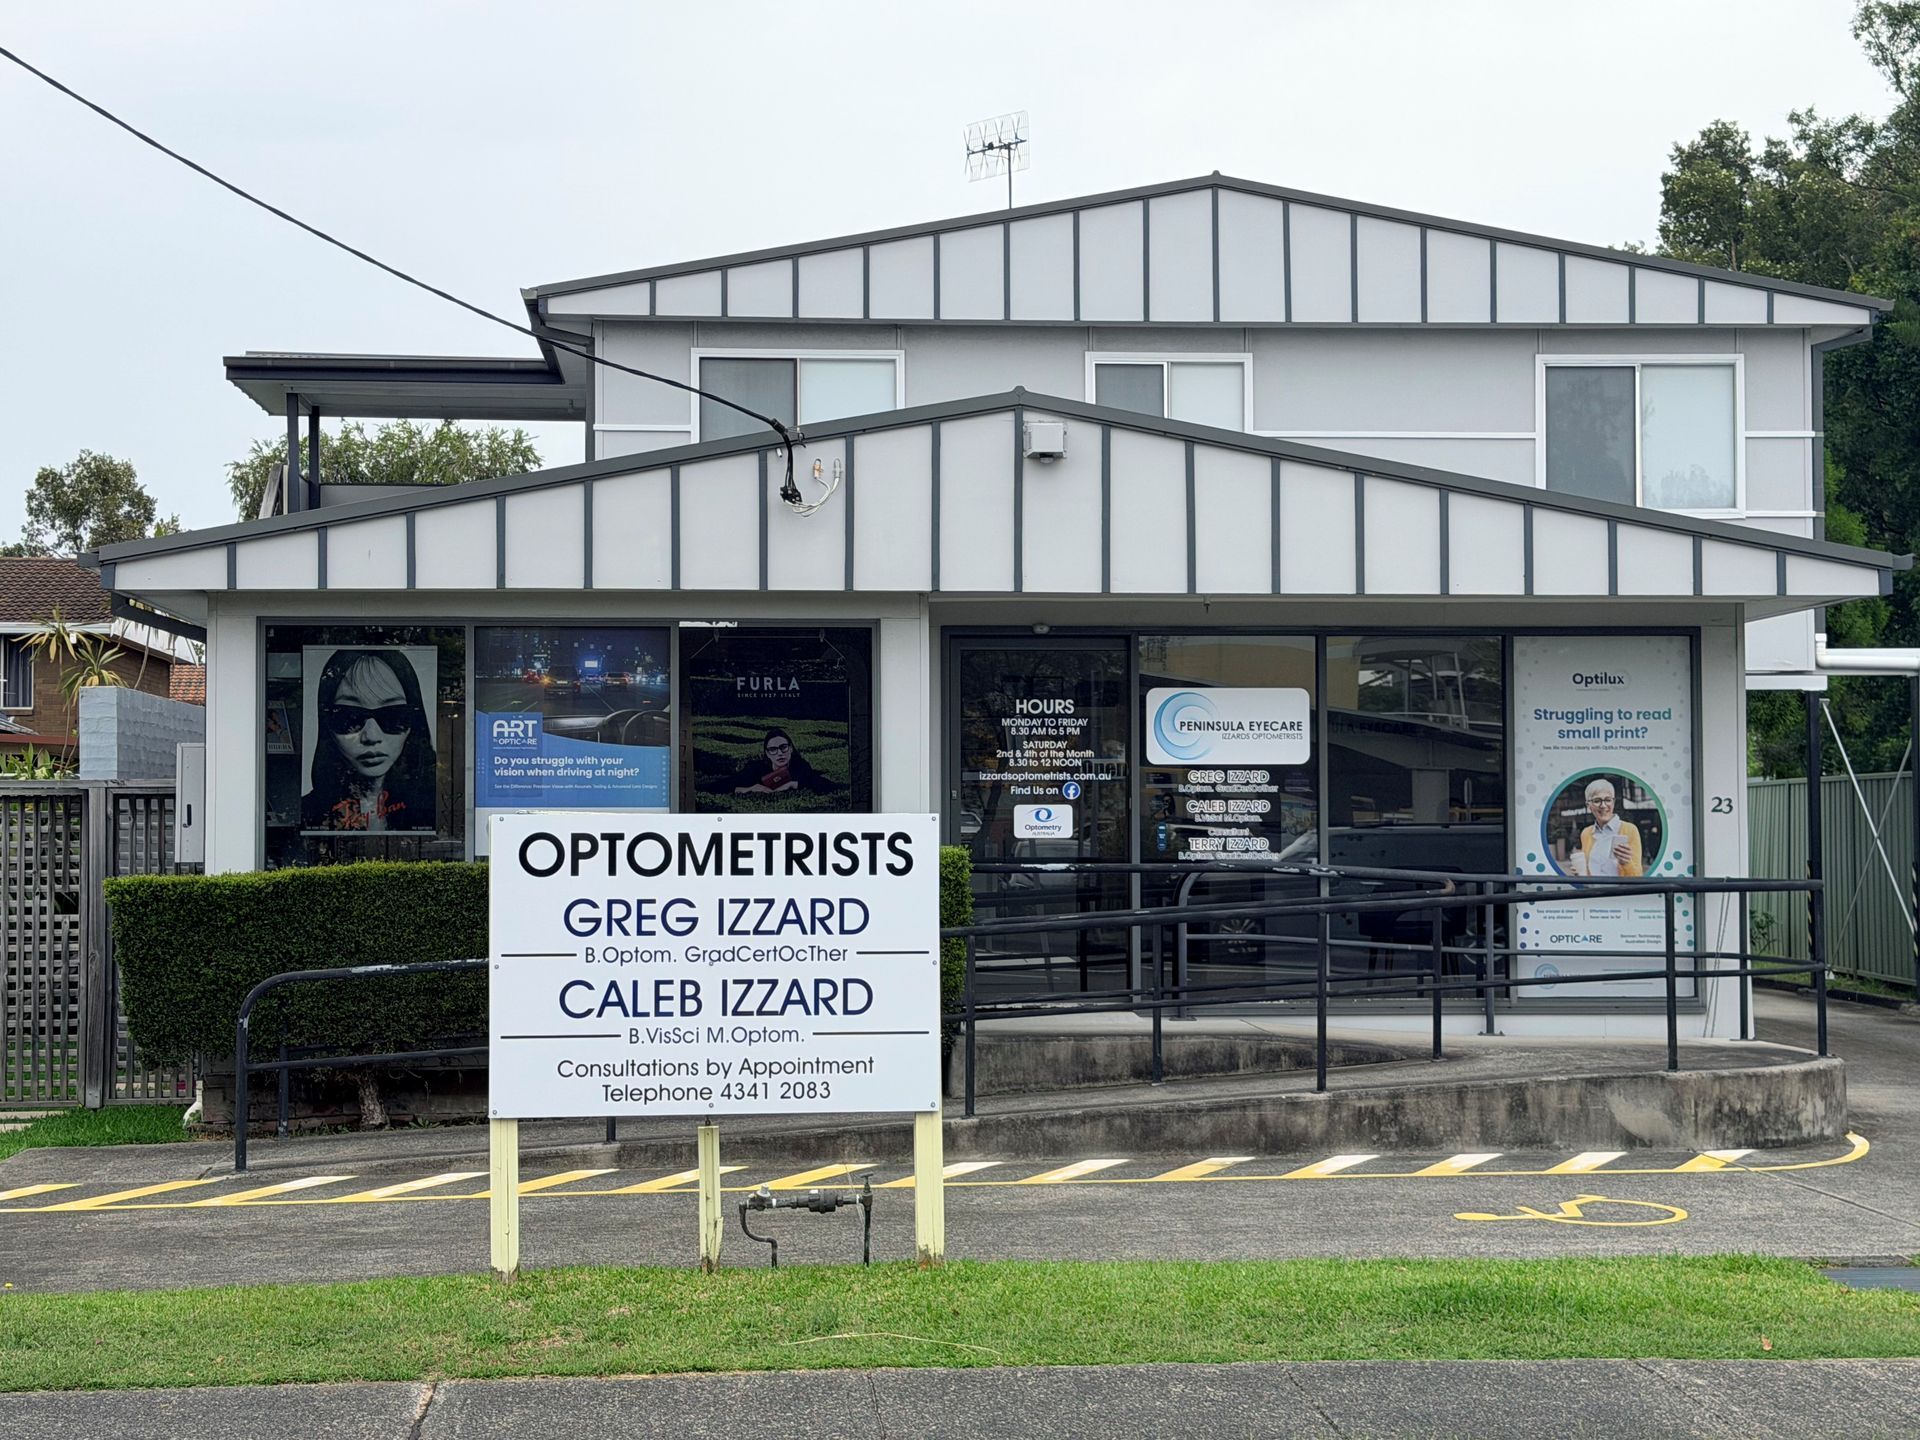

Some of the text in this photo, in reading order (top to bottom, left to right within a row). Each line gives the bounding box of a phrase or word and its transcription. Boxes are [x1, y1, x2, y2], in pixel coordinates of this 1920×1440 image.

[737, 676, 800, 691] FURLA
[1572, 672, 1624, 688] Optilux
[1015, 698, 1075, 714] HOURS
[1002, 718, 1088, 727] MONDAY TO FRIDAY
[1534, 707, 1672, 724] Struggling to read
[492, 720, 538, 738] ART
[1010, 727, 1080, 736] 8.30 AM to 5 PM
[1180, 720, 1303, 732] PENINSULA EYECARE
[1558, 727, 1648, 742] small print?
[1022, 740, 1068, 749] SATURDAY
[996, 750, 1094, 758] 2nd & 4th of the Month
[494, 756, 624, 768] Do you struggle with your
[1008, 759, 1082, 767] 8.30 to 12 NOON
[494, 768, 640, 779] vision when driving at night?
[979, 772, 1112, 782] izzardsoptometrists.com.au
[1187, 770, 1270, 784] GREG IZZARD
[1010, 786, 1031, 795] Find
[1033, 786, 1044, 795] Us
[1186, 800, 1271, 814] CALEB IZZARD
[1711, 796, 1734, 814] 23
[1024, 824, 1062, 834] Optometry
[1188, 838, 1270, 851] TERRY IZZARD
[518, 831, 914, 878] OPTOMETRISTS
[563, 897, 870, 938] GREG IZZARD
[1550, 934, 1602, 944] OPTICARE
[585, 944, 848, 966] B.Optom. GradCertOcTher
[559, 978, 874, 1019] CALEB IZZARD
[628, 1026, 806, 1046] B.VisSci M.Optom.
[557, 1056, 875, 1080] Consultations by Appointment
[602, 1082, 832, 1106] Telephone 4341 2083
